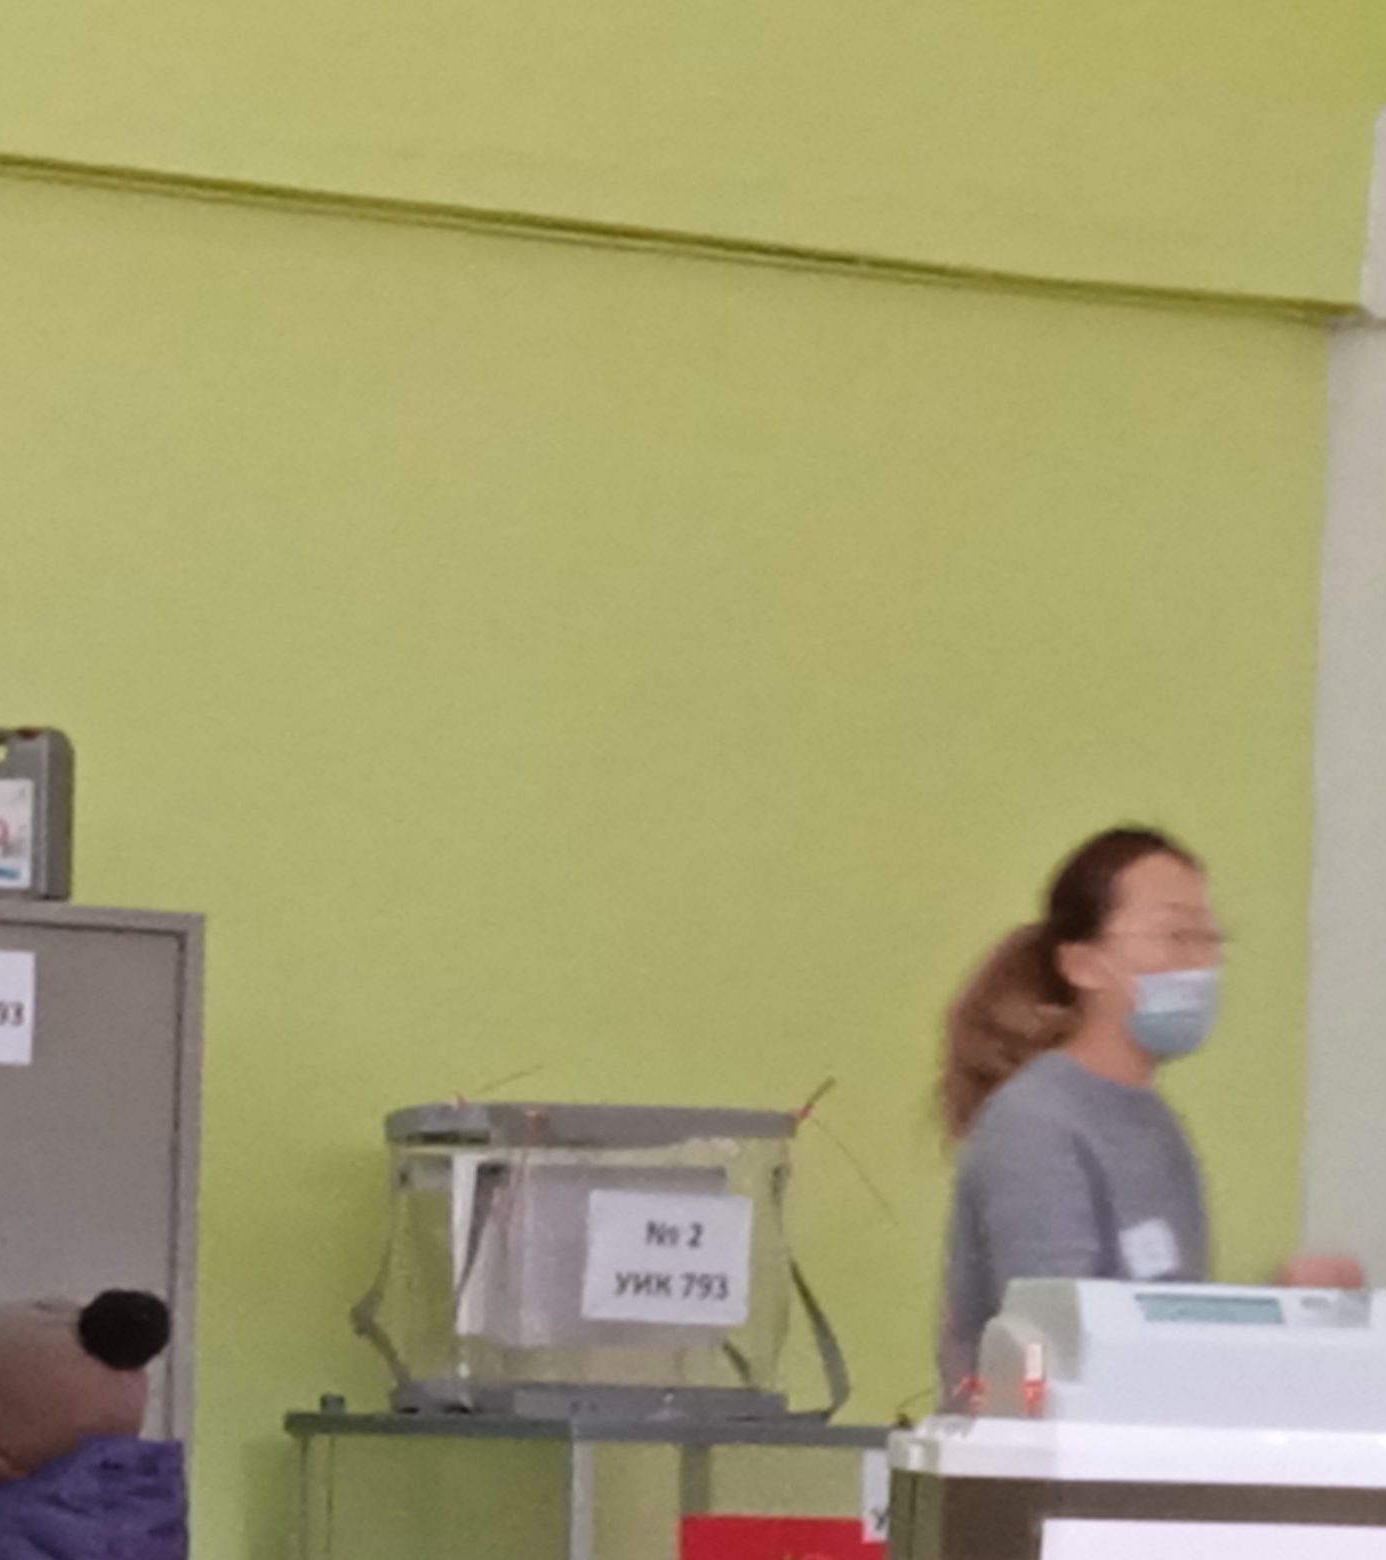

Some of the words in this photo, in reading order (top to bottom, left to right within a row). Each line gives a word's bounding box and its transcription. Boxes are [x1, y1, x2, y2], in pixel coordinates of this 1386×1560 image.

[644, 1220, 681, 1247] №
[687, 1222, 704, 1248] 2
[615, 1271, 673, 1297] УИК
[680, 1273, 729, 1300] 793
